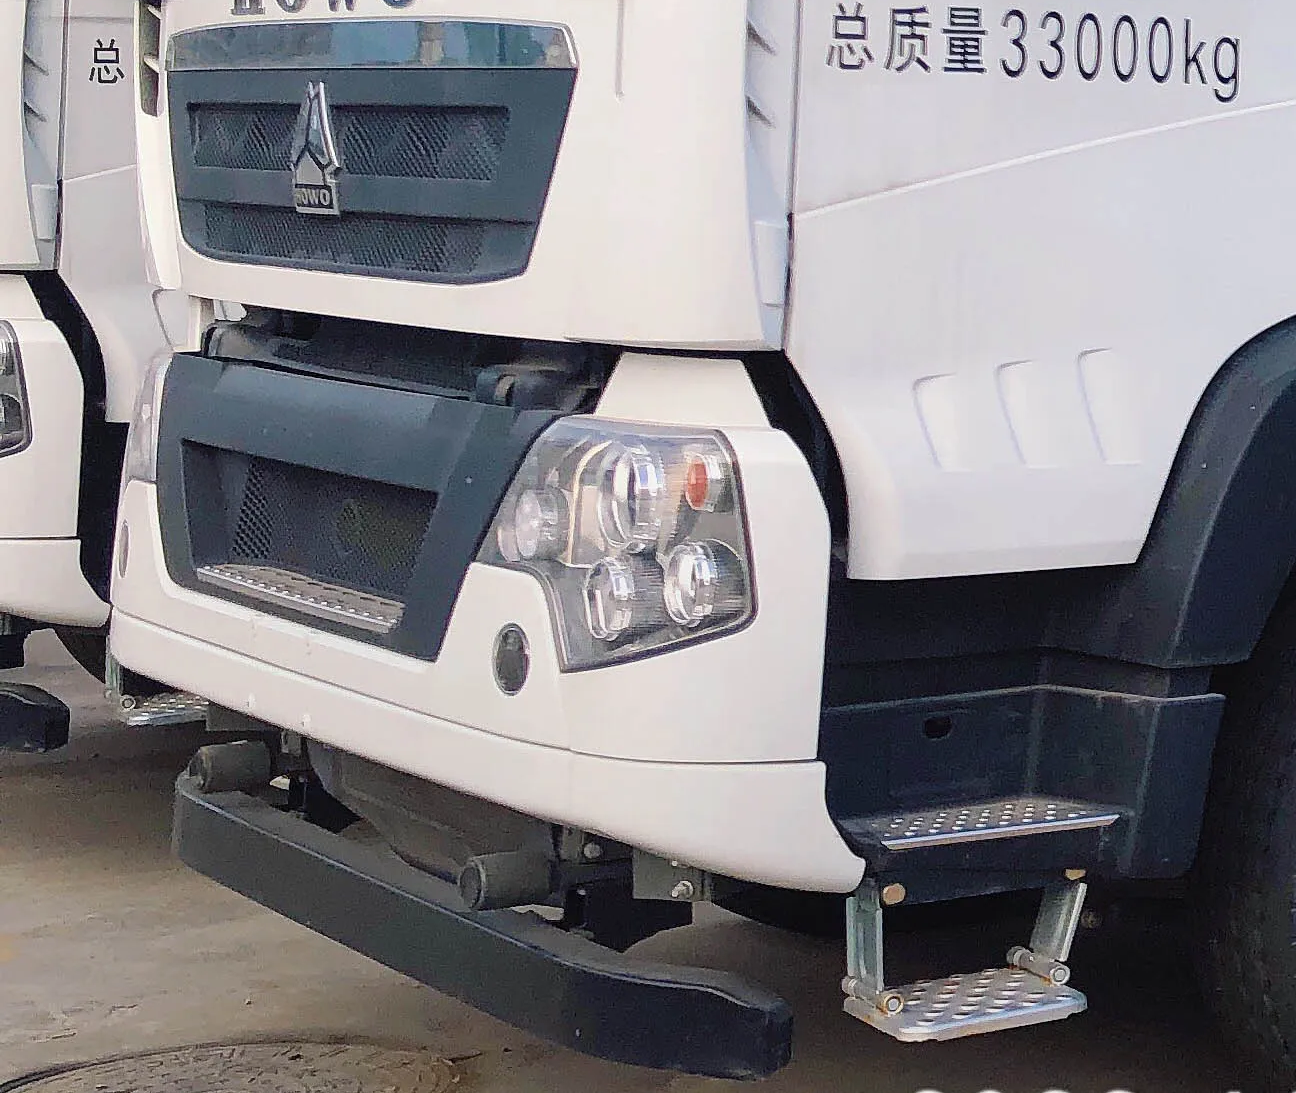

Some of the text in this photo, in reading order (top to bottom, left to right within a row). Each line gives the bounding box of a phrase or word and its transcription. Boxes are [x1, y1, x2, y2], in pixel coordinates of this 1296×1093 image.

[88, 38, 125, 84] 总
[826, 1, 1241, 104] 总质量33000kg
